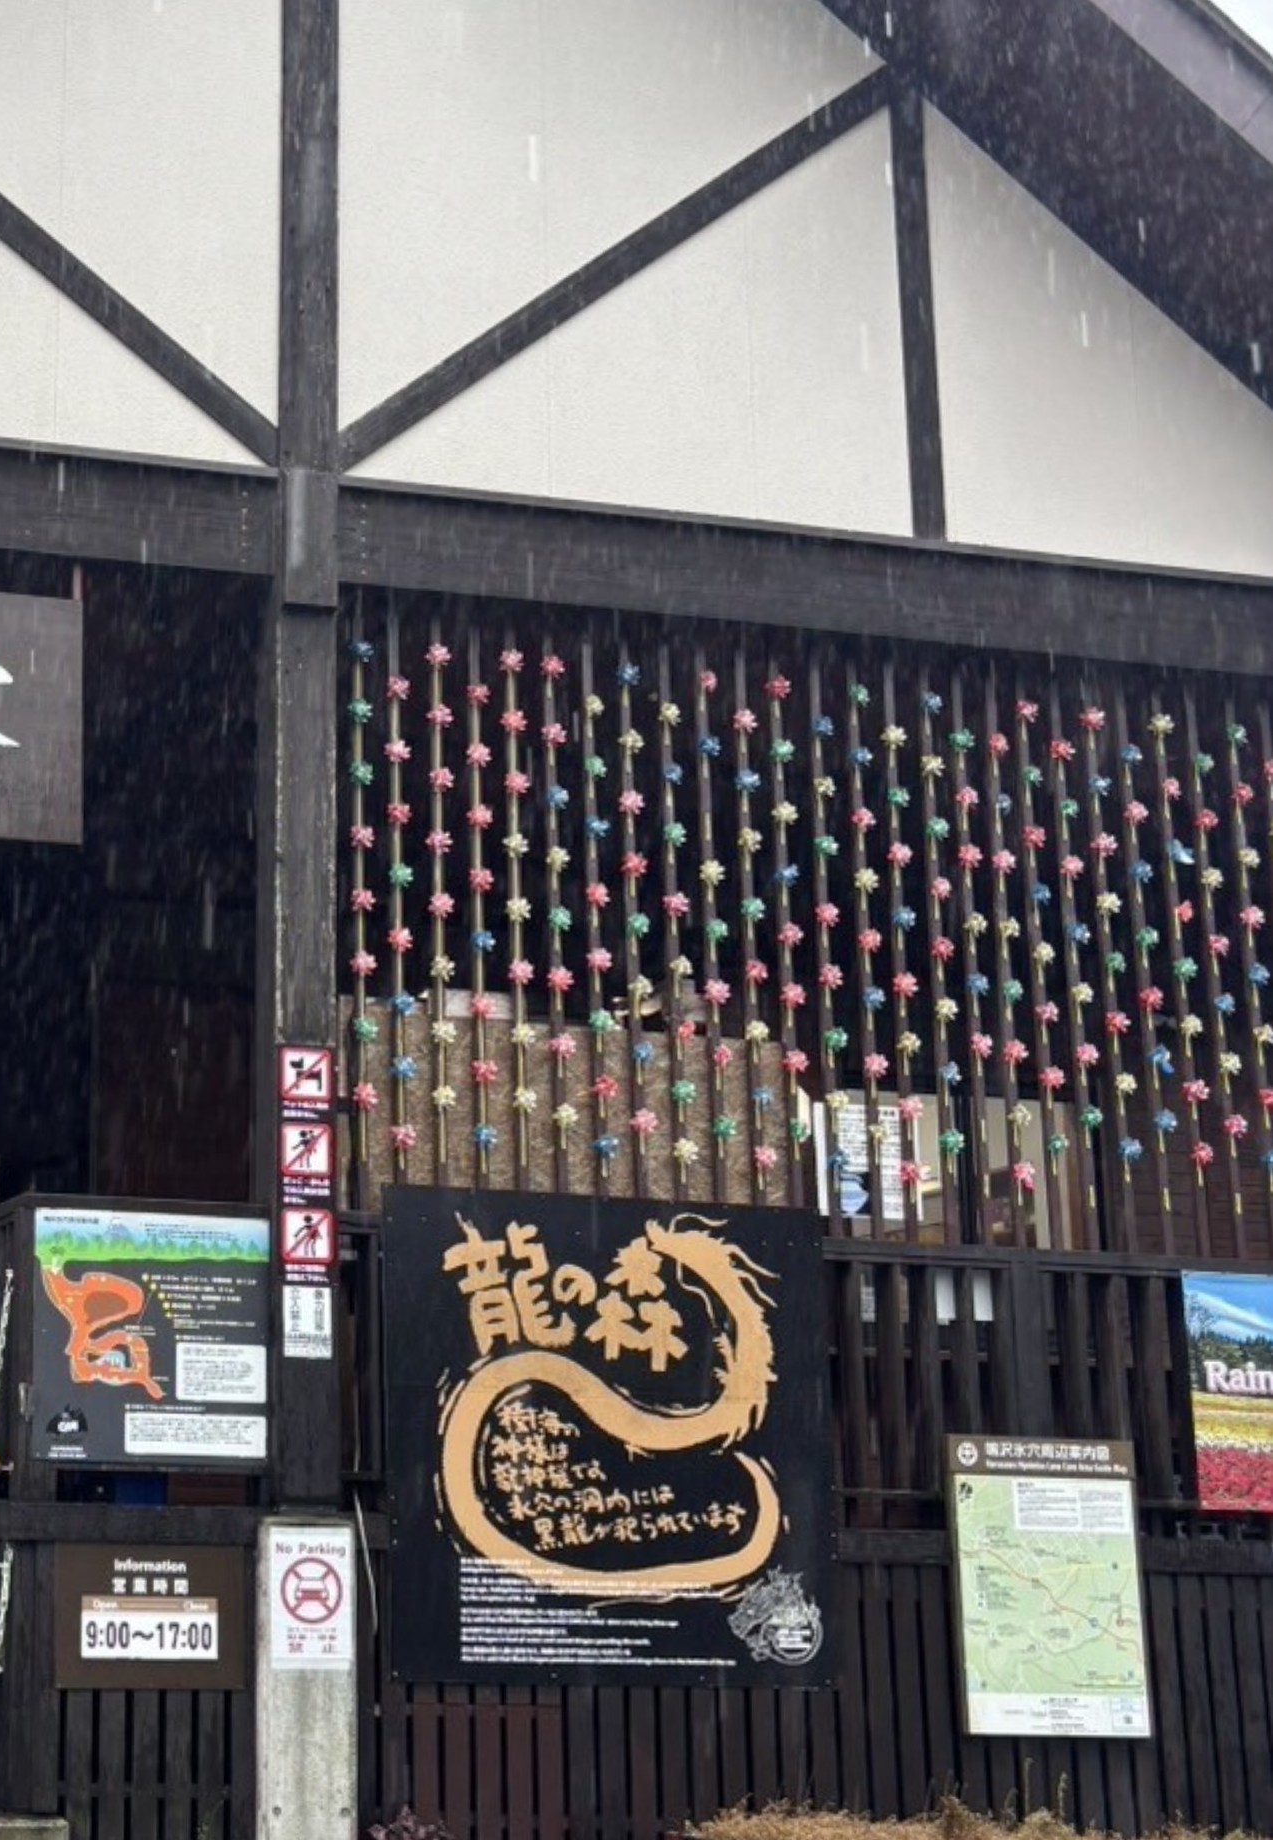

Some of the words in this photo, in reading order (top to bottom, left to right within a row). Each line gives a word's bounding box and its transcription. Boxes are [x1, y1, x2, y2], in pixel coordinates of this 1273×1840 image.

[443, 1211, 690, 1372] 龍の森
[275, 1543, 293, 1554] No
[299, 1543, 346, 1558] Parking
[114, 1558, 187, 1573] Information
